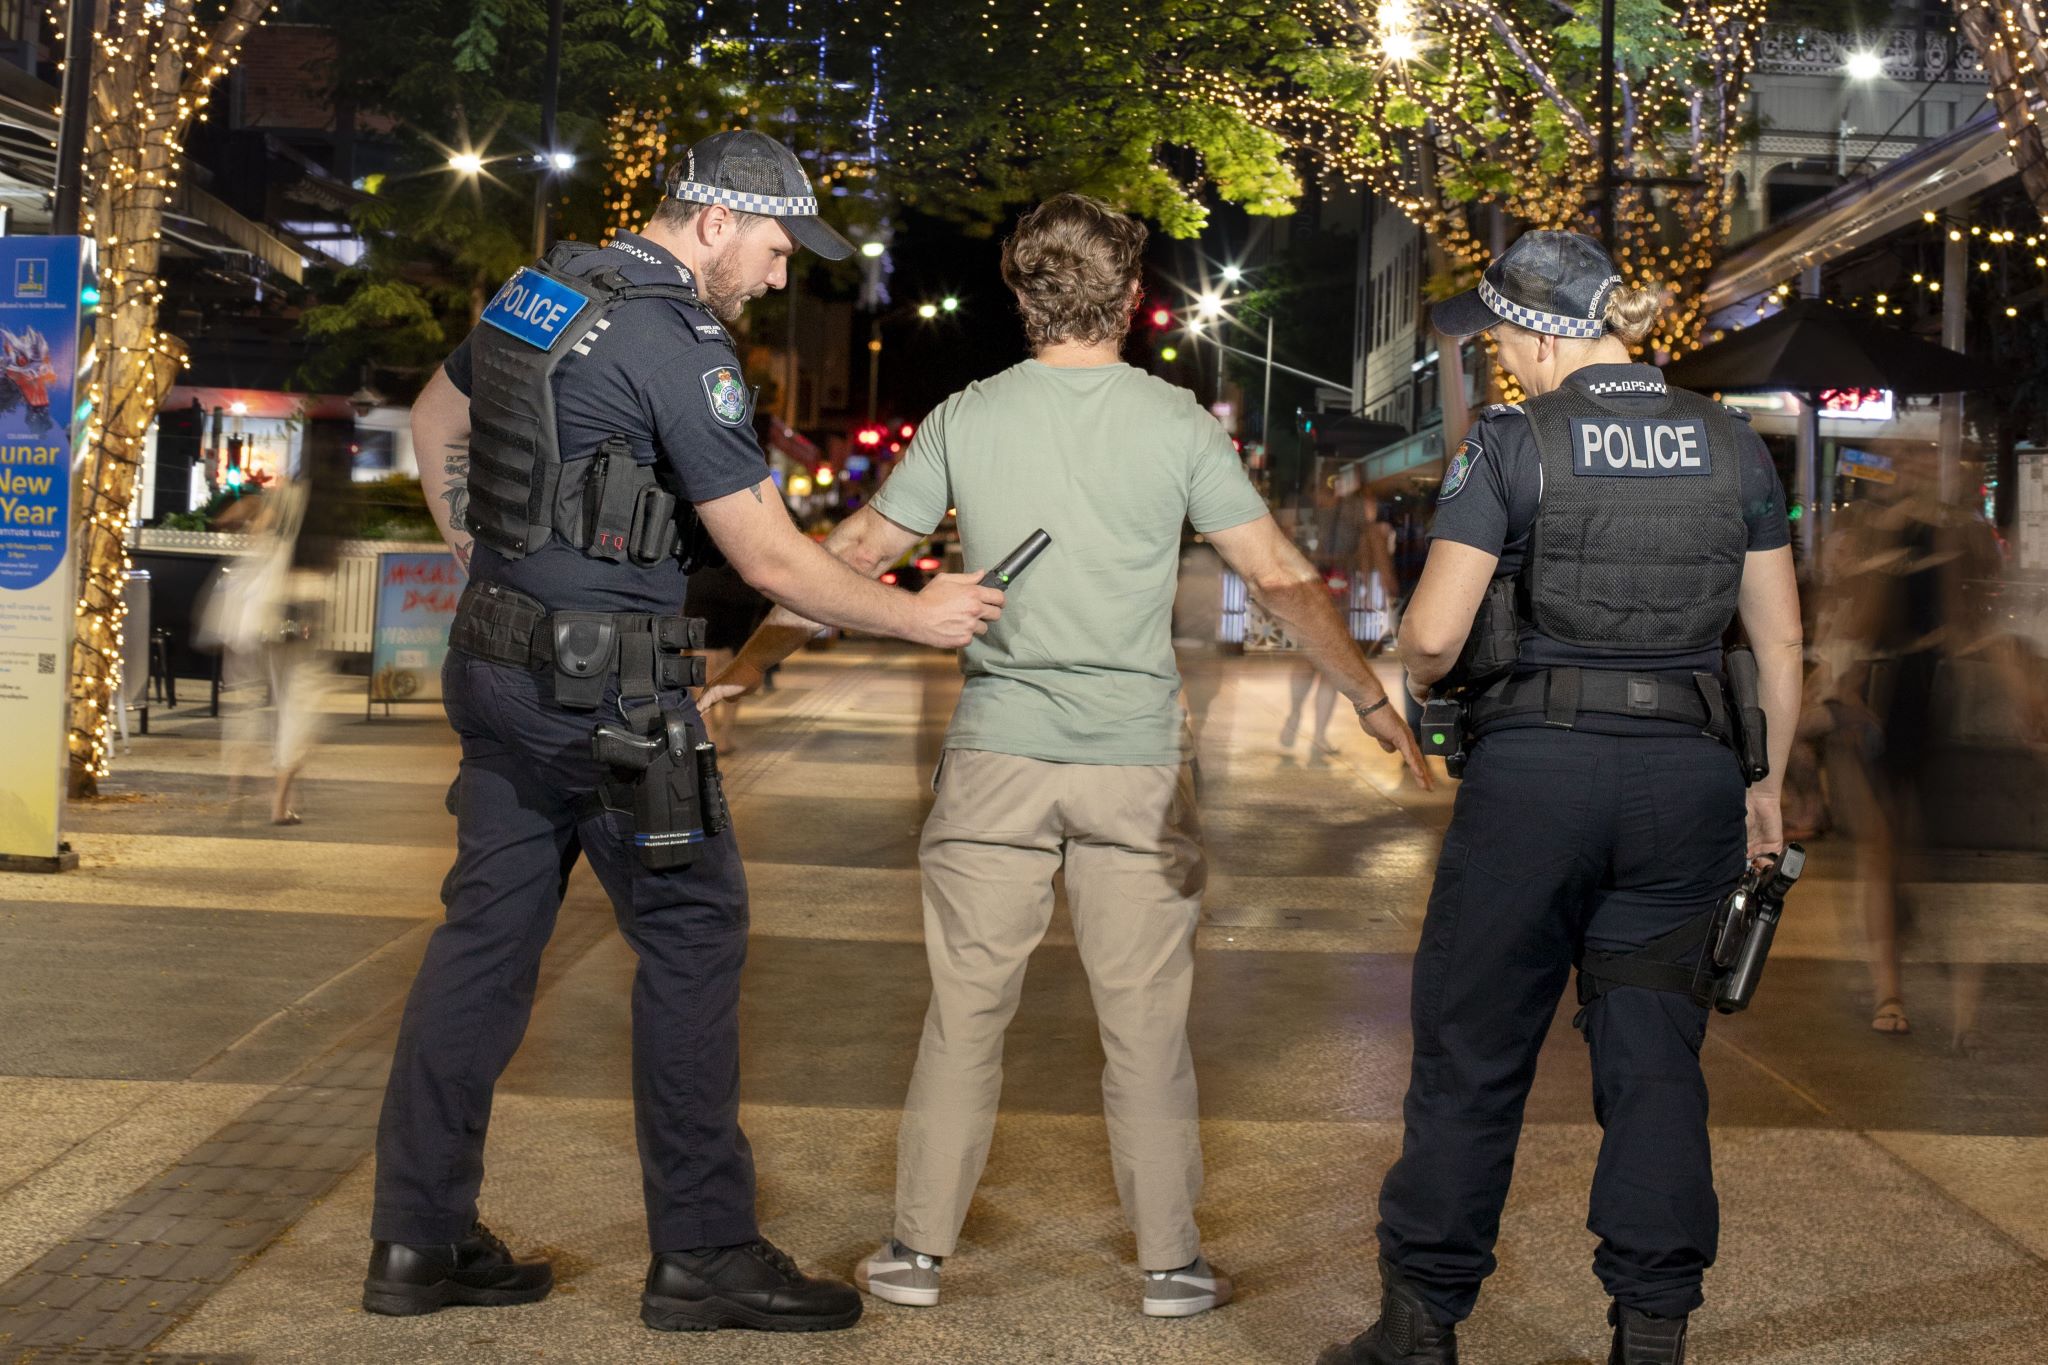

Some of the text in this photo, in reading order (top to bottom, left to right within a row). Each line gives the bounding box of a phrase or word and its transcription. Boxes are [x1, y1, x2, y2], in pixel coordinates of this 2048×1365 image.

[1587, 278, 1610, 319] QUEENSLAND
[1621, 381, 1646, 391] QPS
[0, 446, 60, 466] unar
[1581, 423, 1701, 469] POLICE
[0, 468, 52, 496] New
[0, 497, 58, 525] Year
[32, 529, 61, 538] VALLEY
[401, 589, 457, 613] DEA
